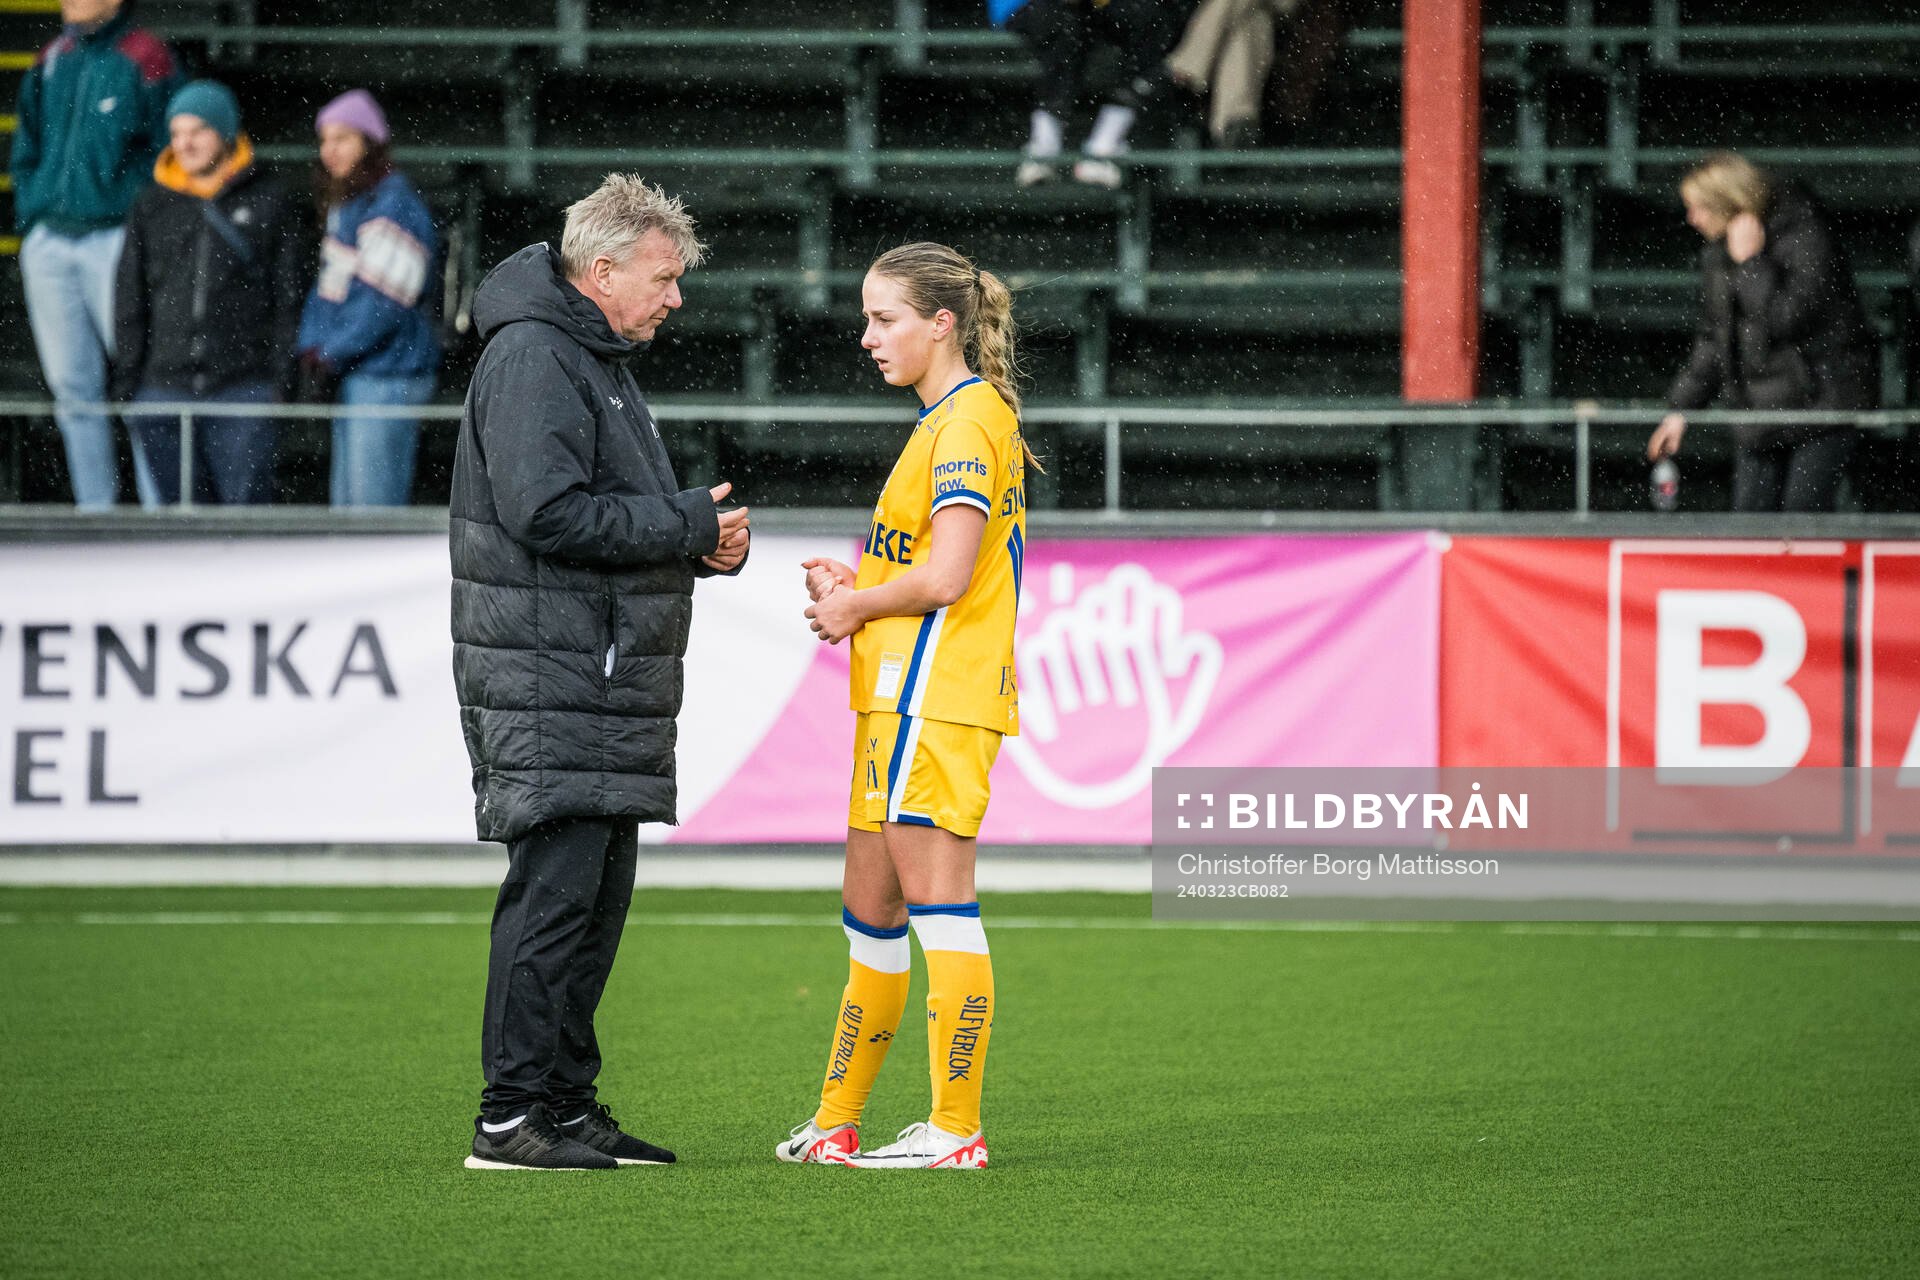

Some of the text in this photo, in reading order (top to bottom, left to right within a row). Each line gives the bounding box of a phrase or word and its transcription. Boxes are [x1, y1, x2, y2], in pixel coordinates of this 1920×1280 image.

[934, 457, 987, 478] morris
[935, 477, 966, 496] law.
[0, 622, 399, 698] ENSKA
[828, 999, 864, 1085] SILFVERLOK
[948, 994, 988, 1082] SILFVERLOK
